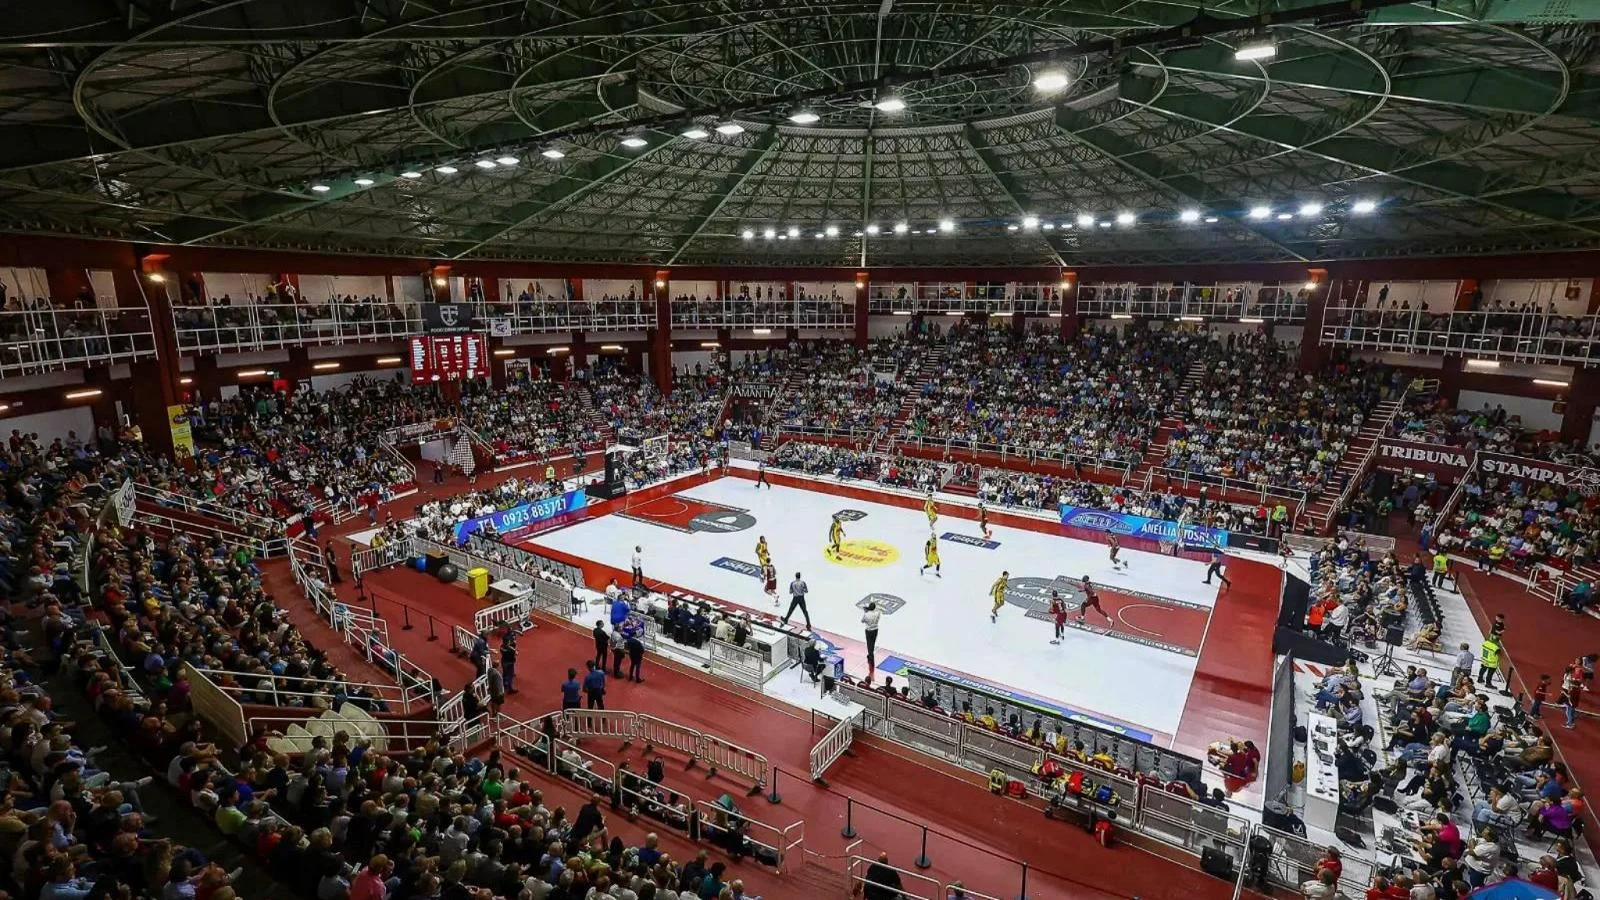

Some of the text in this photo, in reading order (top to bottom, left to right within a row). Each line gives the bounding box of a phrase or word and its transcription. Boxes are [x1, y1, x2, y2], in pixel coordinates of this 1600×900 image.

[1380, 445, 1468, 467] TRIBUNA
[1482, 459, 1566, 485] STAMPA
[502, 509, 529, 526] 0923
[531, 499, 567, 517] 883727
[1141, 522, 1222, 544] ANELLIATOSRLIT
